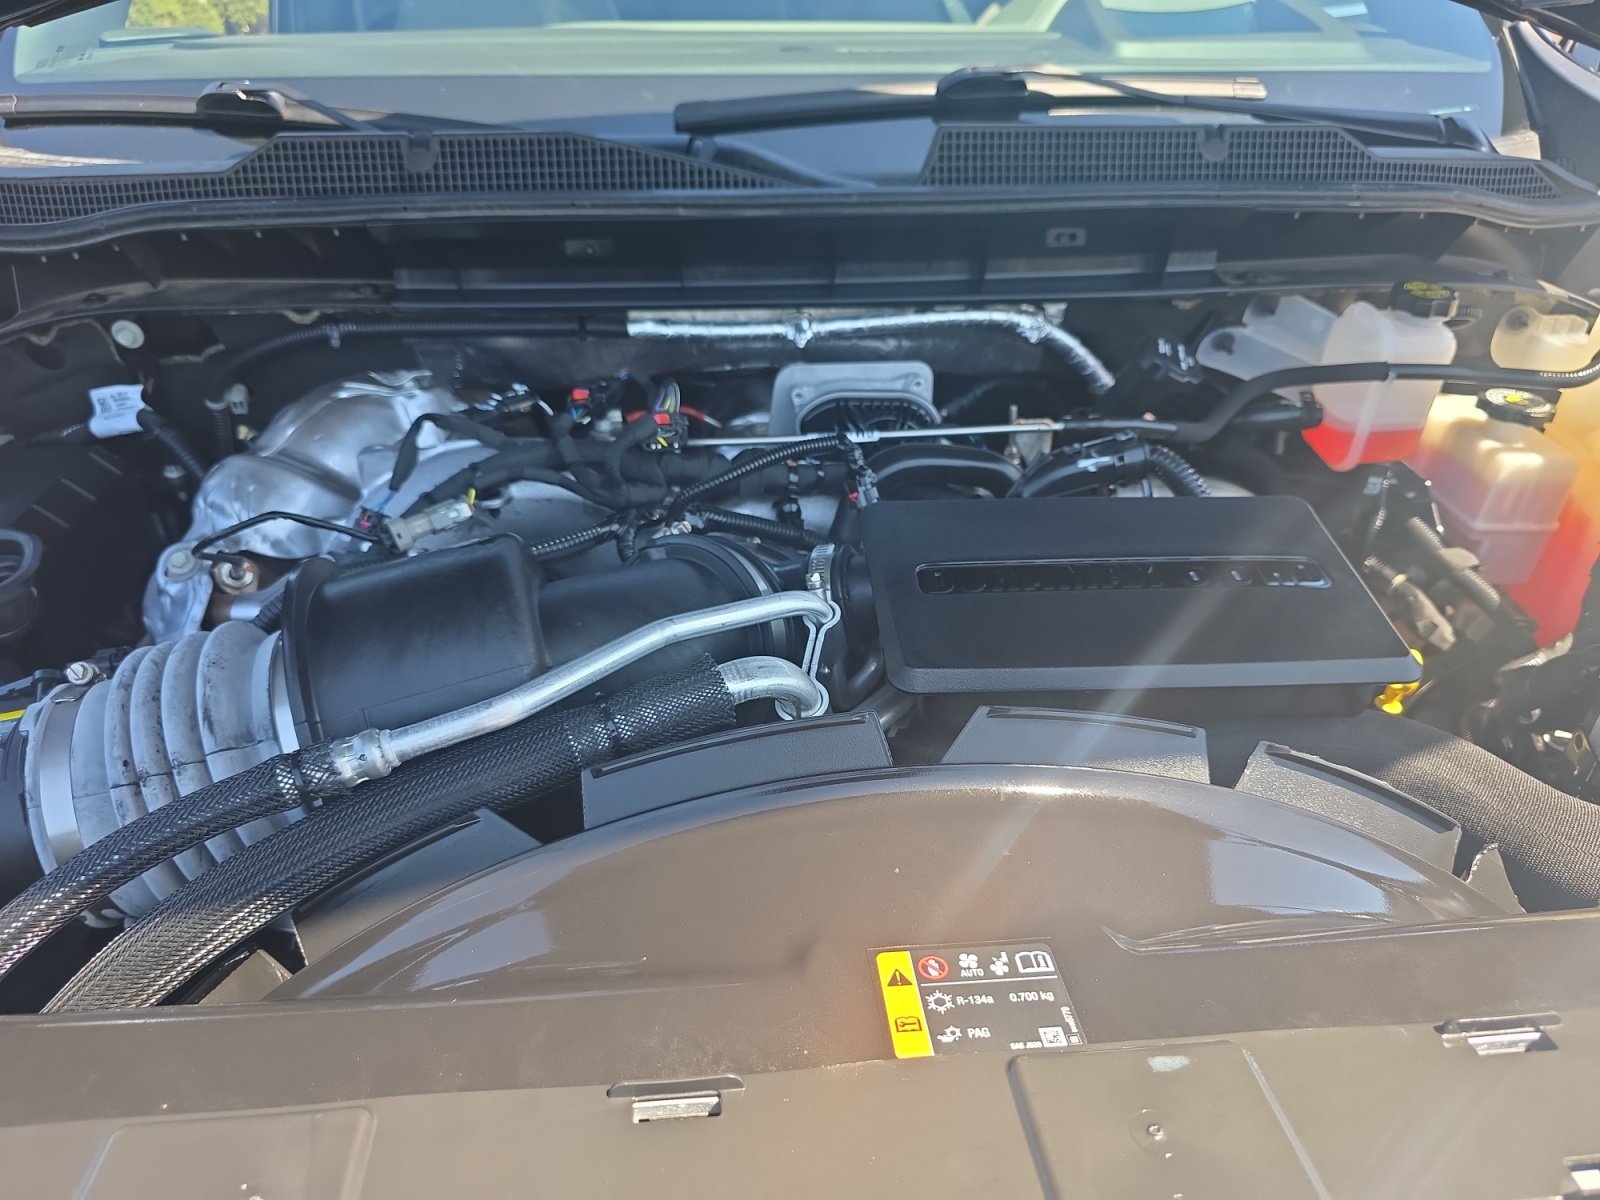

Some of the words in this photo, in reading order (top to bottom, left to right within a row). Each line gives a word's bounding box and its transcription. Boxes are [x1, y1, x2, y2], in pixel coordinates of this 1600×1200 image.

[960, 968, 984, 978] AUTO
[956, 995, 995, 1006] R-134a
[1009, 992, 1039, 1003] 0.700
[1039, 991, 1055, 1002] kg
[967, 1027, 991, 1039] PAG
